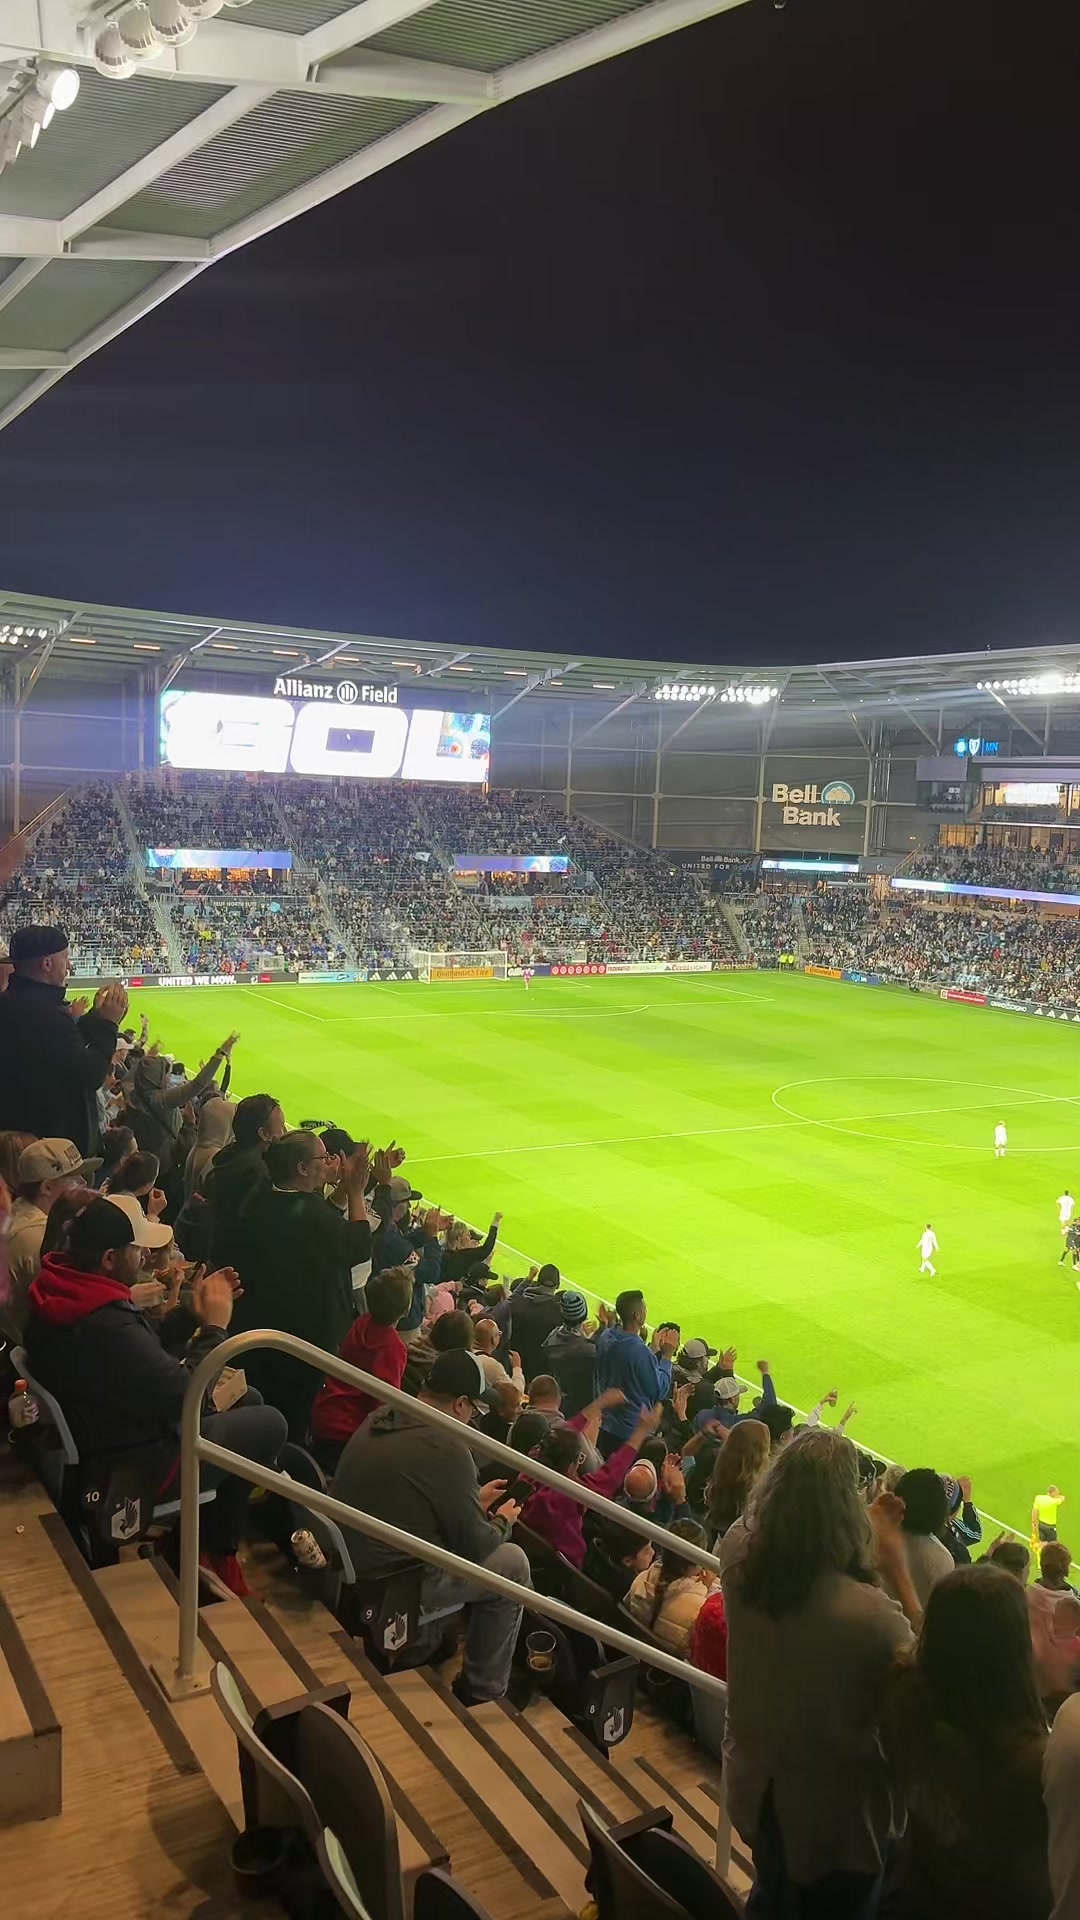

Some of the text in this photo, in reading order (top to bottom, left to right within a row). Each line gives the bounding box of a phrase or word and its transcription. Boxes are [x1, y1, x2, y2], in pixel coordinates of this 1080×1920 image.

[273, 678, 398, 704] Allianz Field
[166, 691, 488, 782] GOL
[985, 741, 999, 752] MN
[771, 783, 818, 804] Bell
[782, 806, 841, 827] Bank
[723, 856, 740, 864] Bank
[158, 977, 193, 987] UNITED
[194, 976, 210, 986] WE
[85, 1491, 101, 1503] 10
[366, 1609, 373, 1620] 9
[589, 1704, 596, 1714] 8
